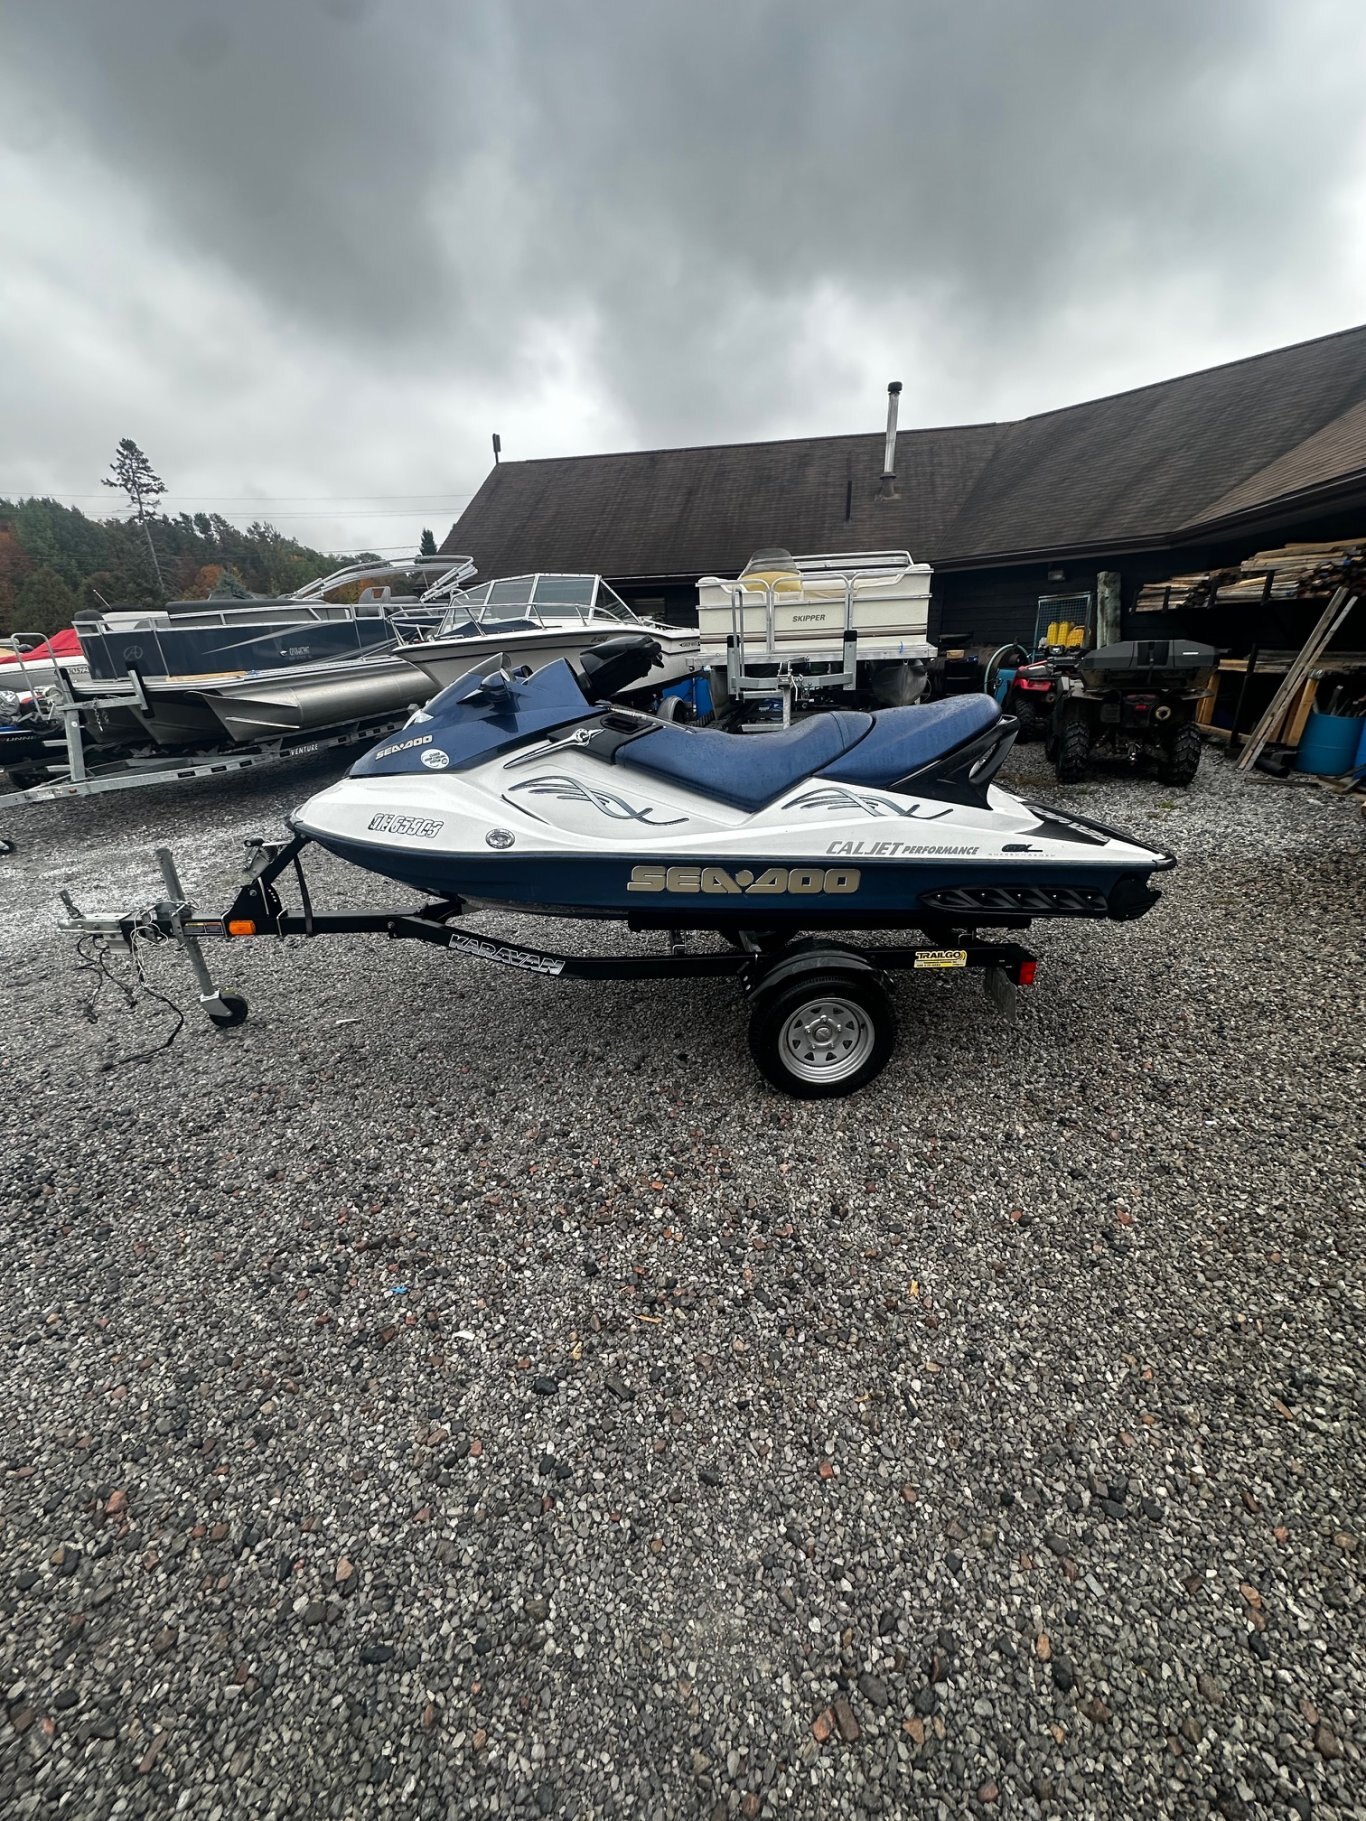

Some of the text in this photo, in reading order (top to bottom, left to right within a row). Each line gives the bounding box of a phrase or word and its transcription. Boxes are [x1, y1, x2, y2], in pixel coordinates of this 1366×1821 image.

[792, 614, 826, 622] SKIPPER
[290, 743, 318, 756] VENTURE
[826, 841, 980, 856] CALJET PERFORMANCE
[449, 934, 566, 975] KARAVAN
[916, 951, 962, 959] TRAILGO
